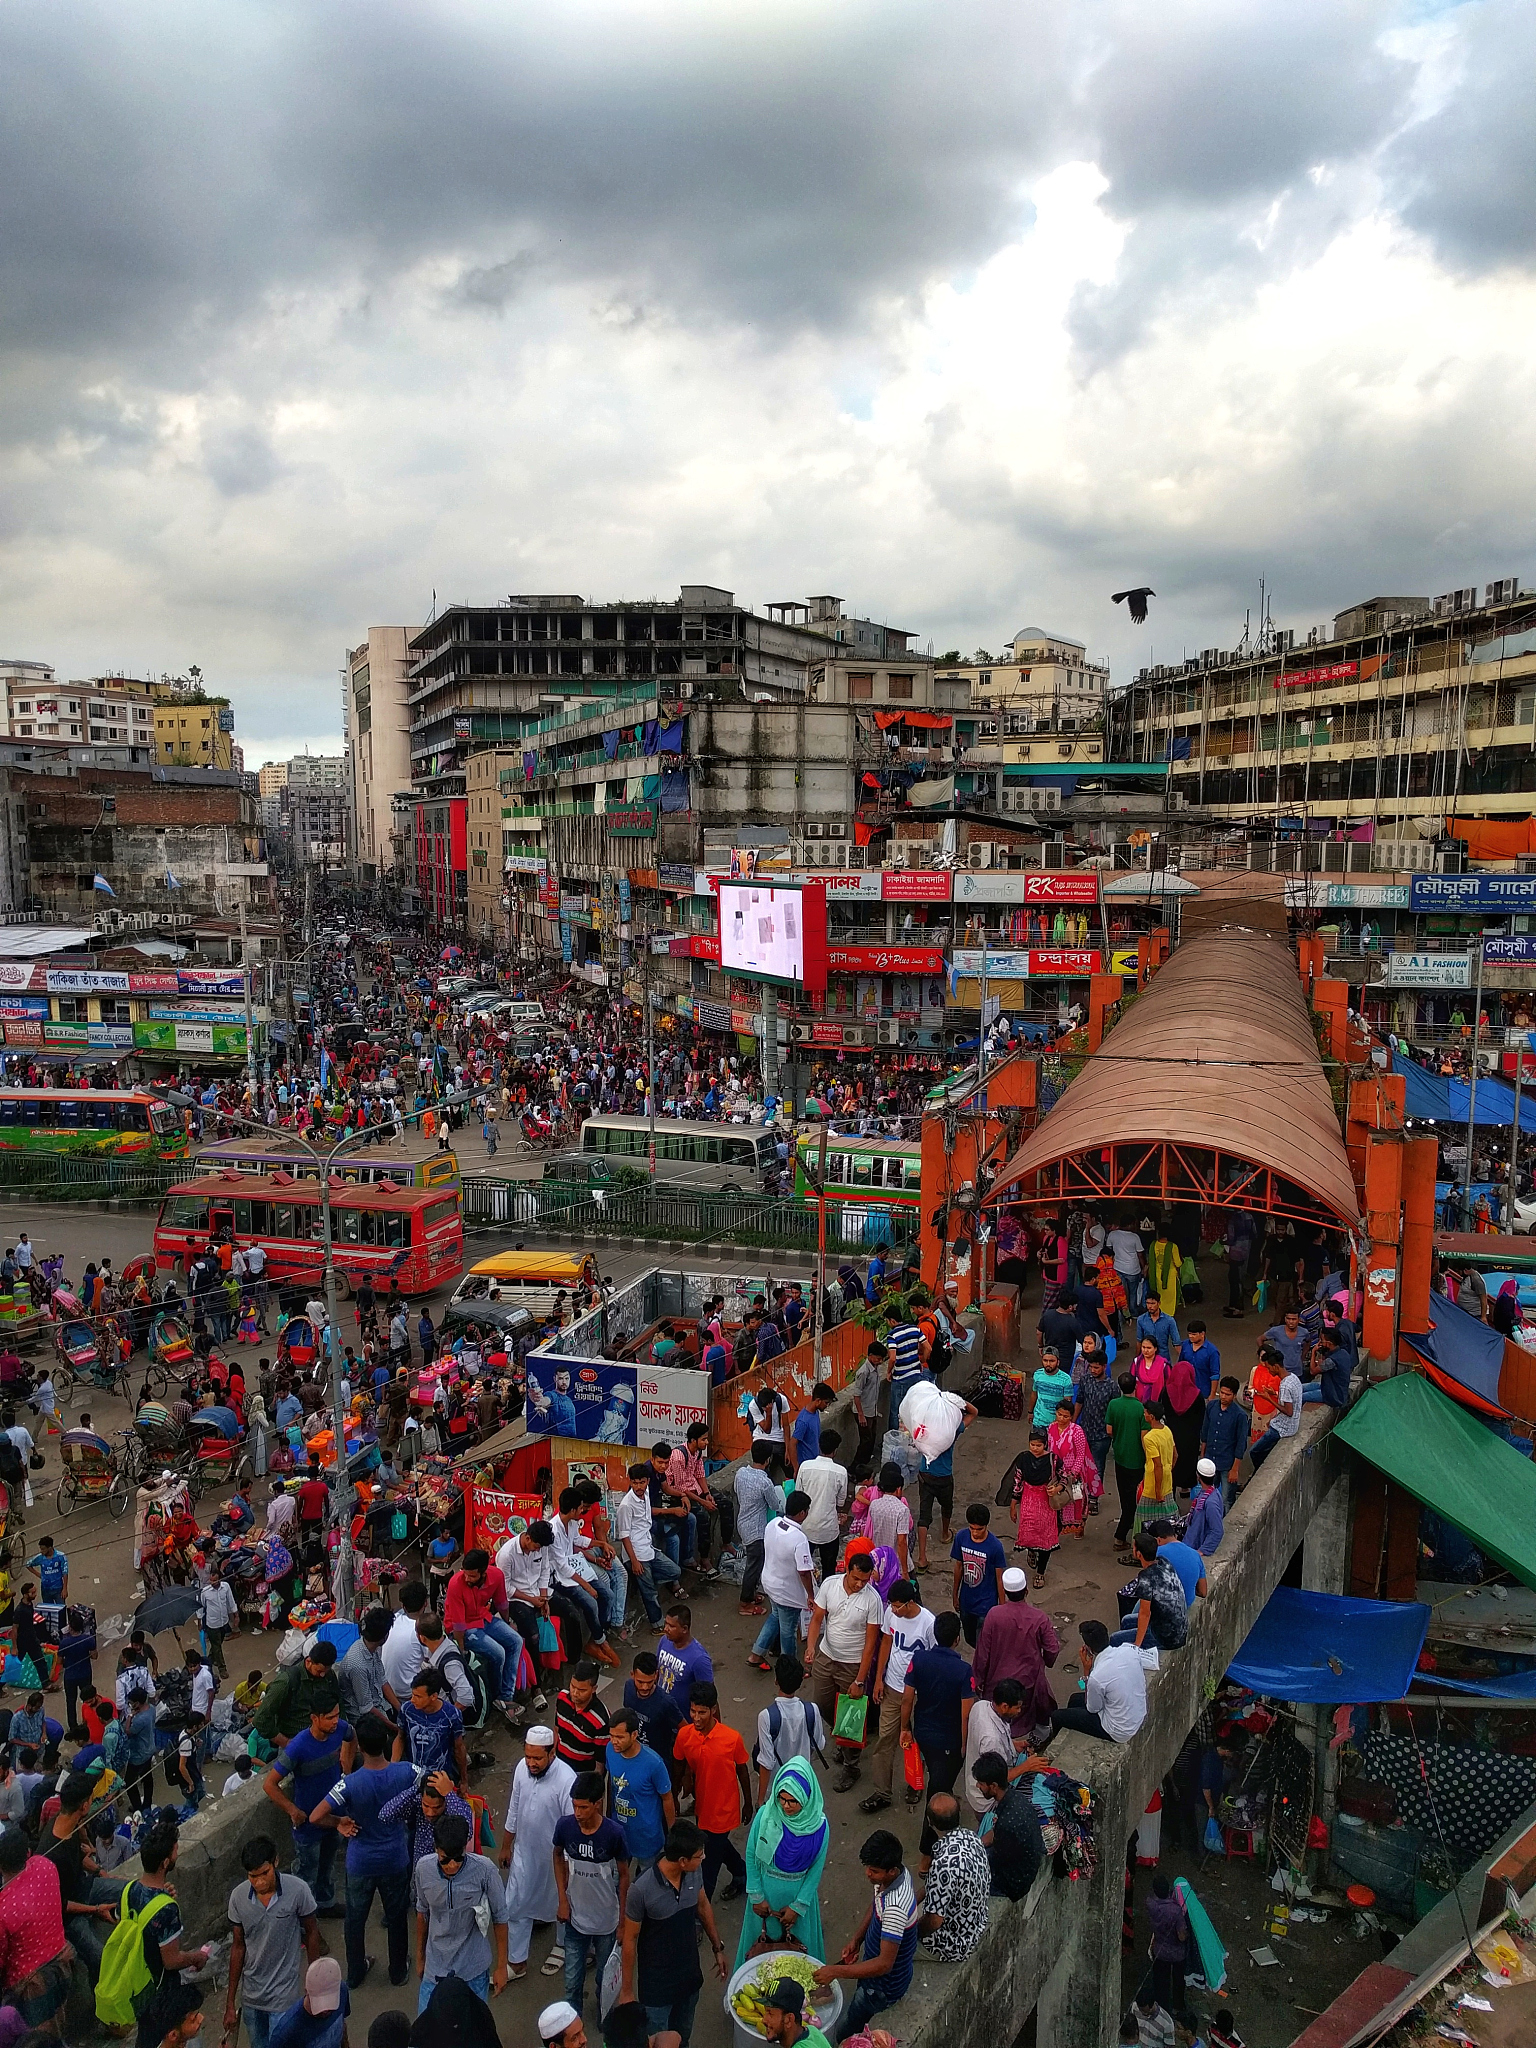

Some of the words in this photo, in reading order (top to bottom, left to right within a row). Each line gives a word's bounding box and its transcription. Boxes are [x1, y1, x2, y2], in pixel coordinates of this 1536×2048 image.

[886, 874, 914, 884] ঢাকাইয়া
[916, 874, 946, 884] জামদানি
[972, 883, 1018, 898] প্রজাপতি
[1415, 876, 1481, 899] মৌসুমী
[1486, 937, 1529, 956] মৌসুমী
[1037, 952, 1092, 965] চন্দ্রালয়
[1409, 956, 1419, 967] A
[1422, 956, 1429, 967] 1
[1432, 960, 1468, 968] FASHION
[48, 971, 78, 987] পাকিজা
[80, 972, 99, 986] তাঁত
[101, 976, 127, 988] বাজার
[104, 1034, 131, 1042] COLLECTION
[1438, 1250, 1477, 1258] PLATINUM
[640, 1381, 659, 1395] নিউ
[639, 1400, 672, 1421] আনন্দ
[659, 1649, 687, 1673] EMPIRE
